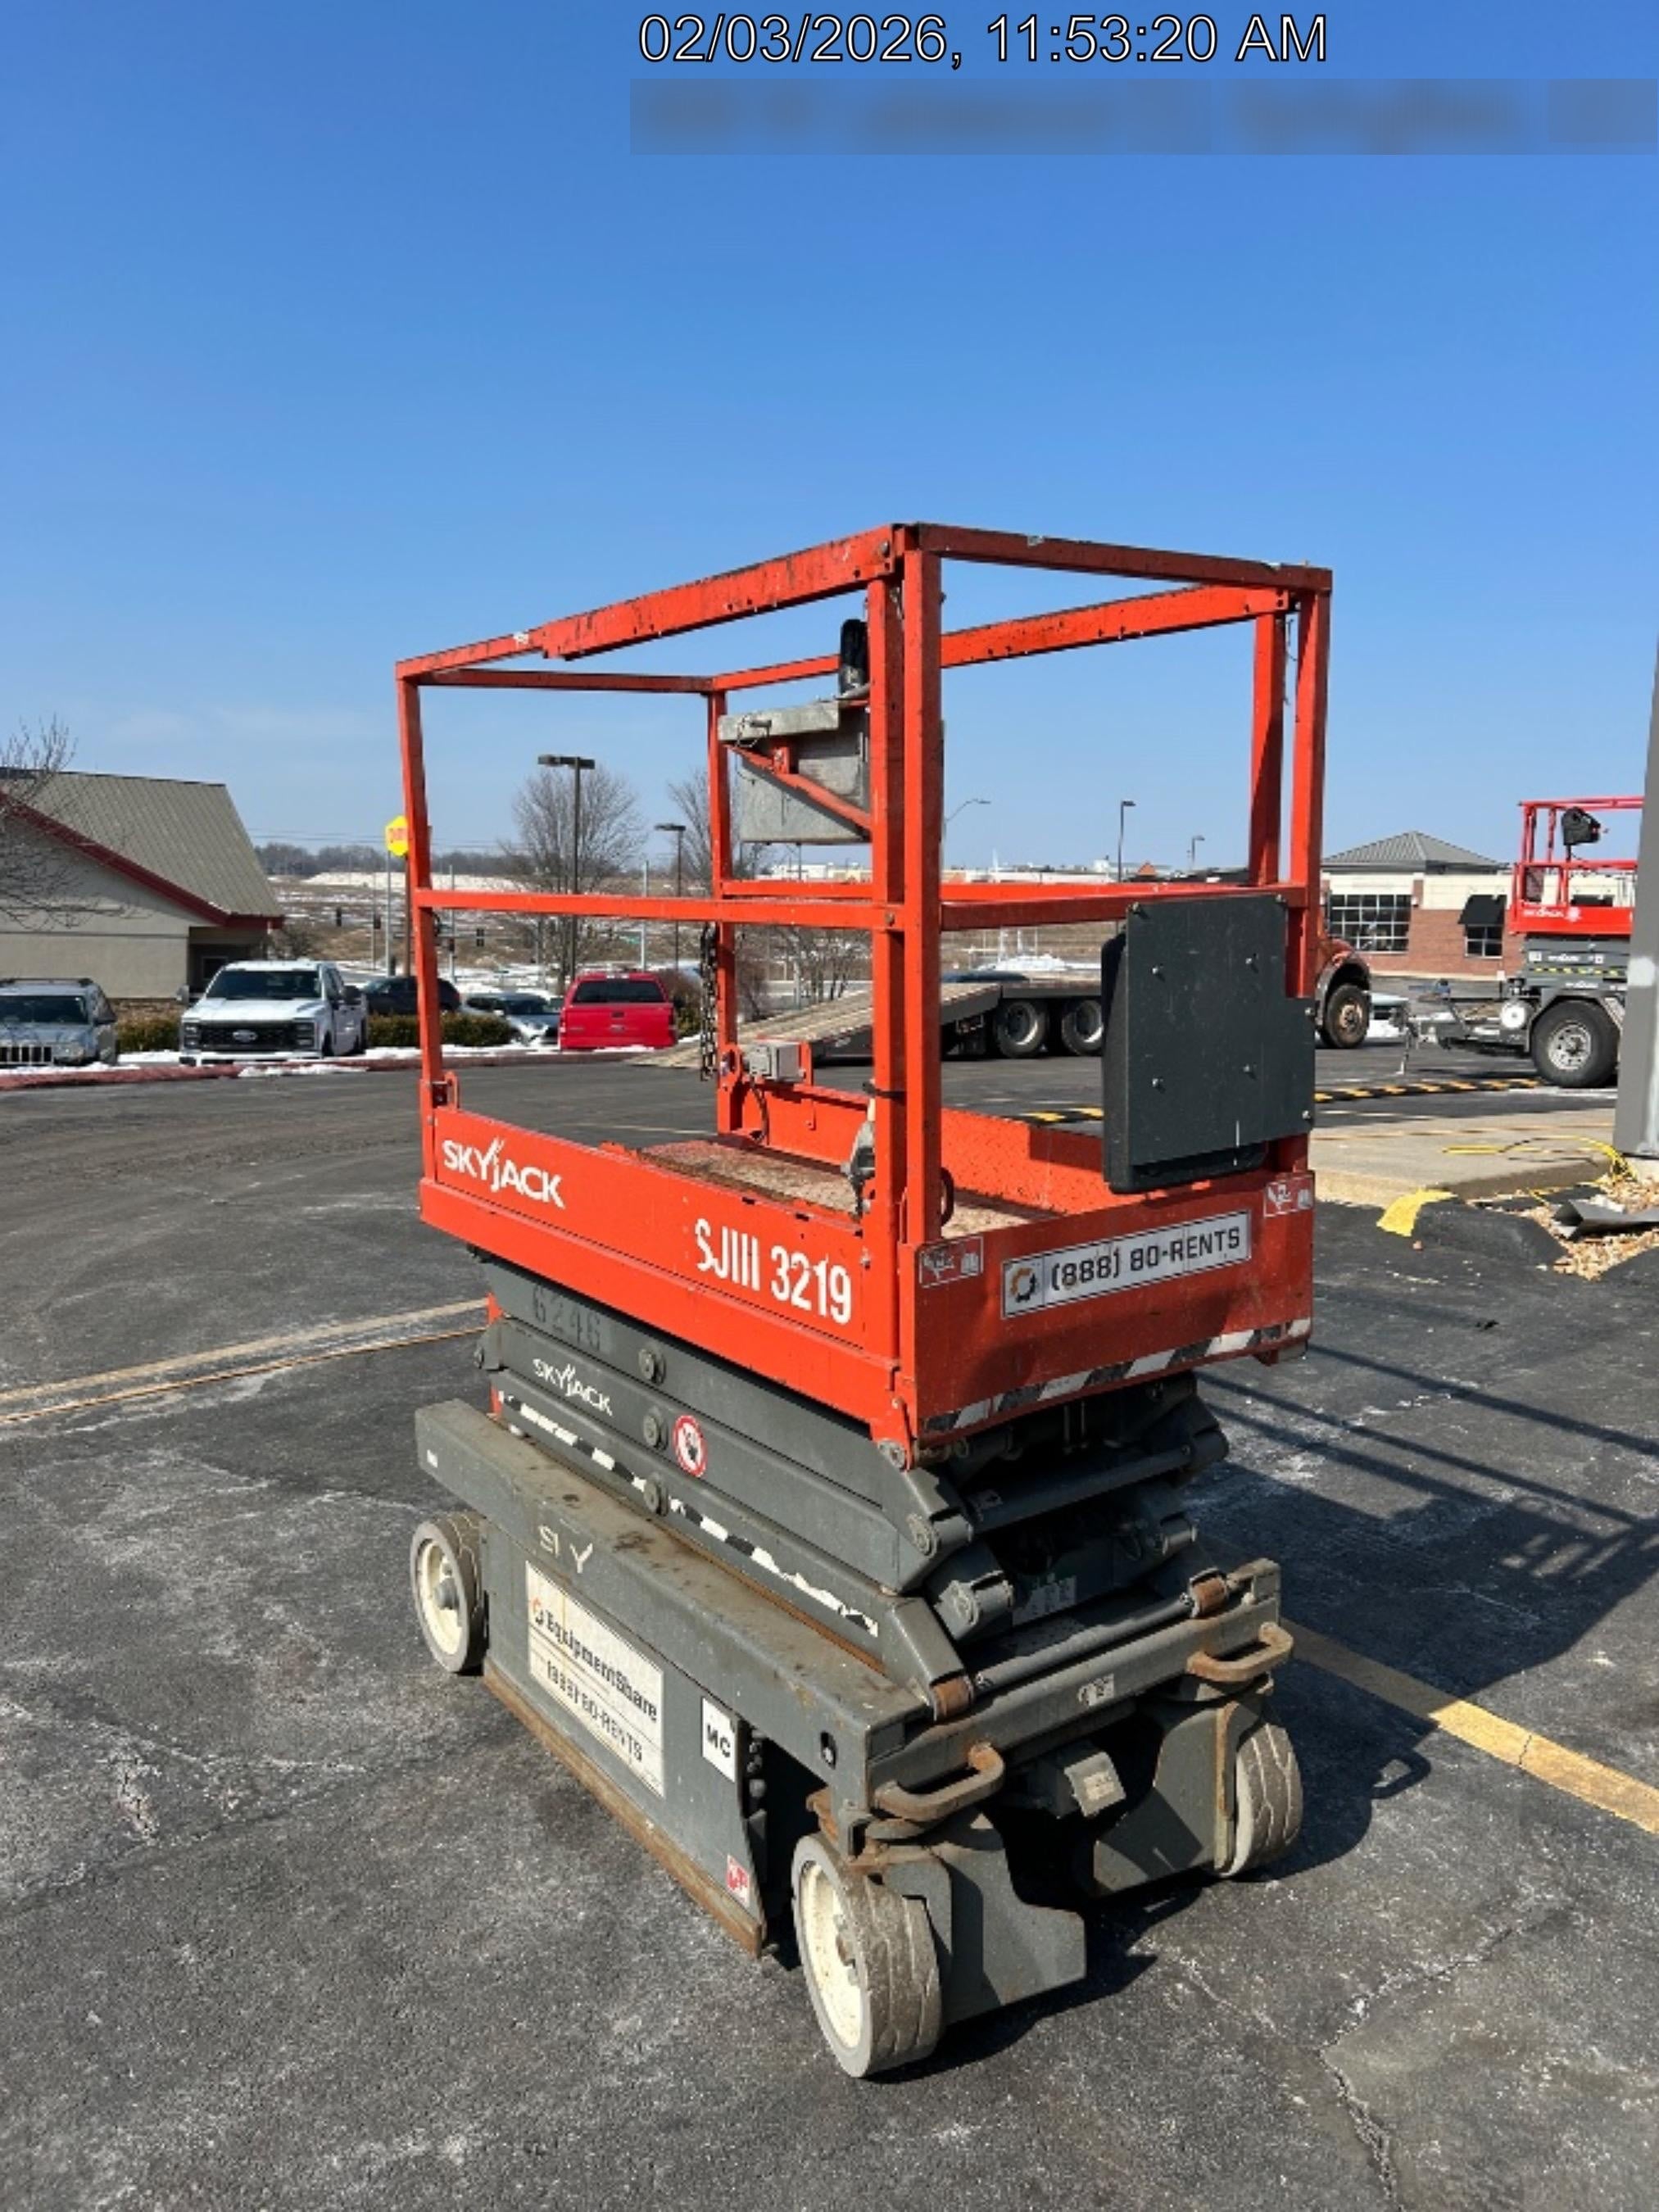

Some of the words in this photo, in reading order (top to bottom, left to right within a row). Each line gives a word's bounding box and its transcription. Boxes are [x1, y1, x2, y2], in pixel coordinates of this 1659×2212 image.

[442, 1136, 565, 1209] SKYJACK
[771, 1244, 853, 1326] 3219
[1051, 1246, 1120, 1291] (888)
[1130, 1226, 1240, 1271] 80-RENTS
[533, 1358, 613, 1416] SKYJACK
